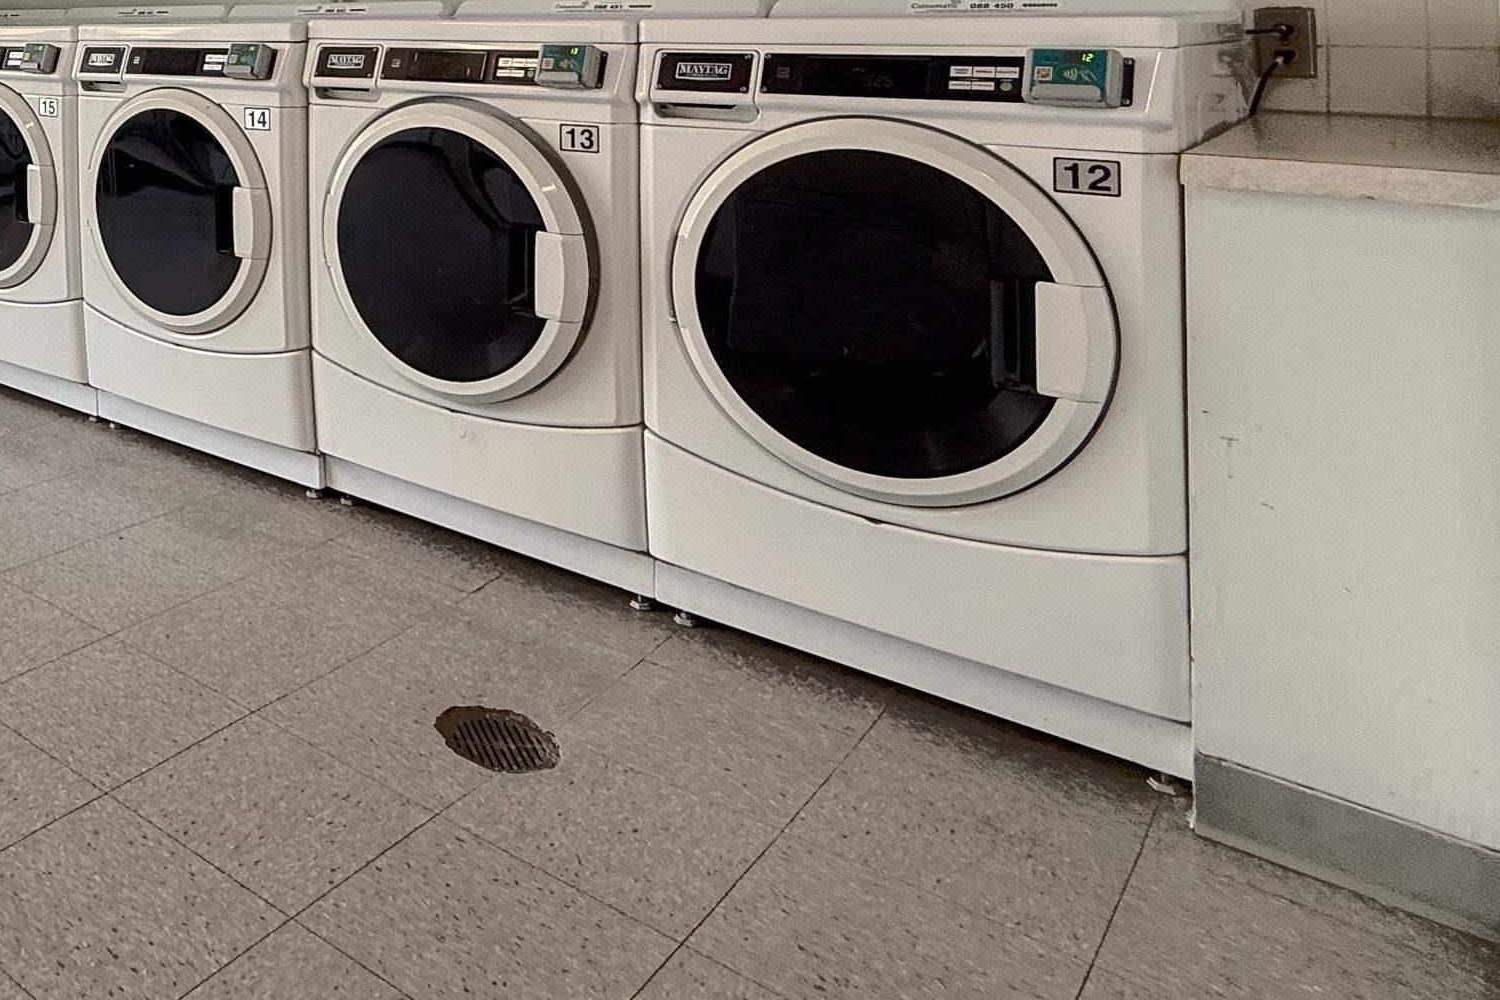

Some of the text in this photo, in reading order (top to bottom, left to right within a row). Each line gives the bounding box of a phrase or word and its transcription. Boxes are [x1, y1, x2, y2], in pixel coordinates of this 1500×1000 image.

[570, 47, 579, 55] 13
[331, 55, 362, 64] MAYTAG
[1082, 53, 1094, 63] 12
[679, 64, 729, 75] MAYTAG
[41, 100, 56, 115] 15
[248, 110, 267, 128] 14
[566, 128, 594, 150] 13
[1064, 162, 1112, 192] 12
